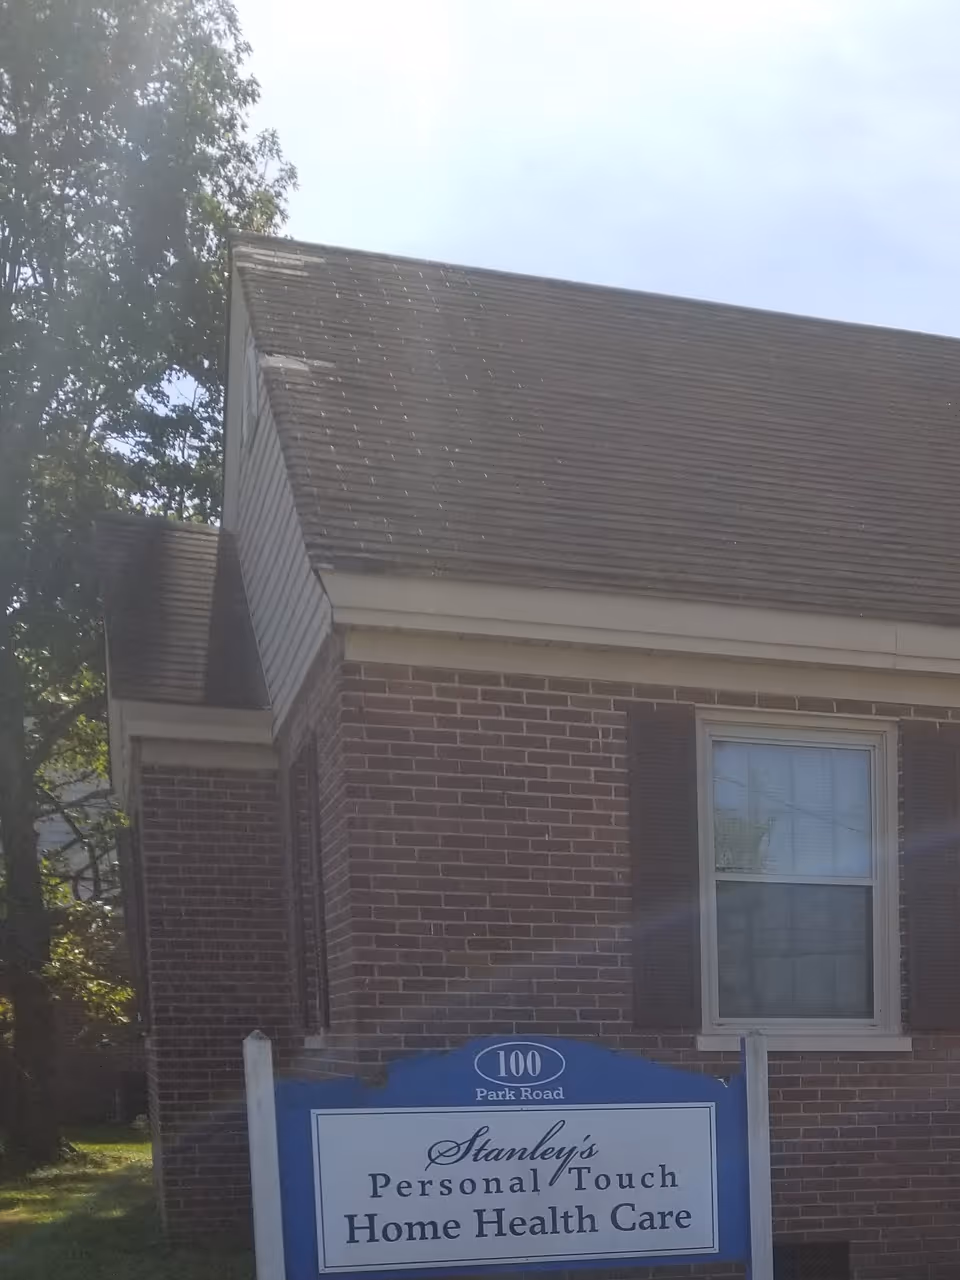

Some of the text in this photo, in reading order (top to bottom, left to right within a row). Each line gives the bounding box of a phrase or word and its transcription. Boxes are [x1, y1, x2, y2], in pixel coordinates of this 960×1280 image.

[496, 1050, 542, 1078] 100
[475, 1086, 565, 1101] Park Road
[425, 1119, 599, 1187] Stanley's
[368, 1164, 679, 1198] Personal Touch
[344, 1202, 693, 1244] Home Health Care
